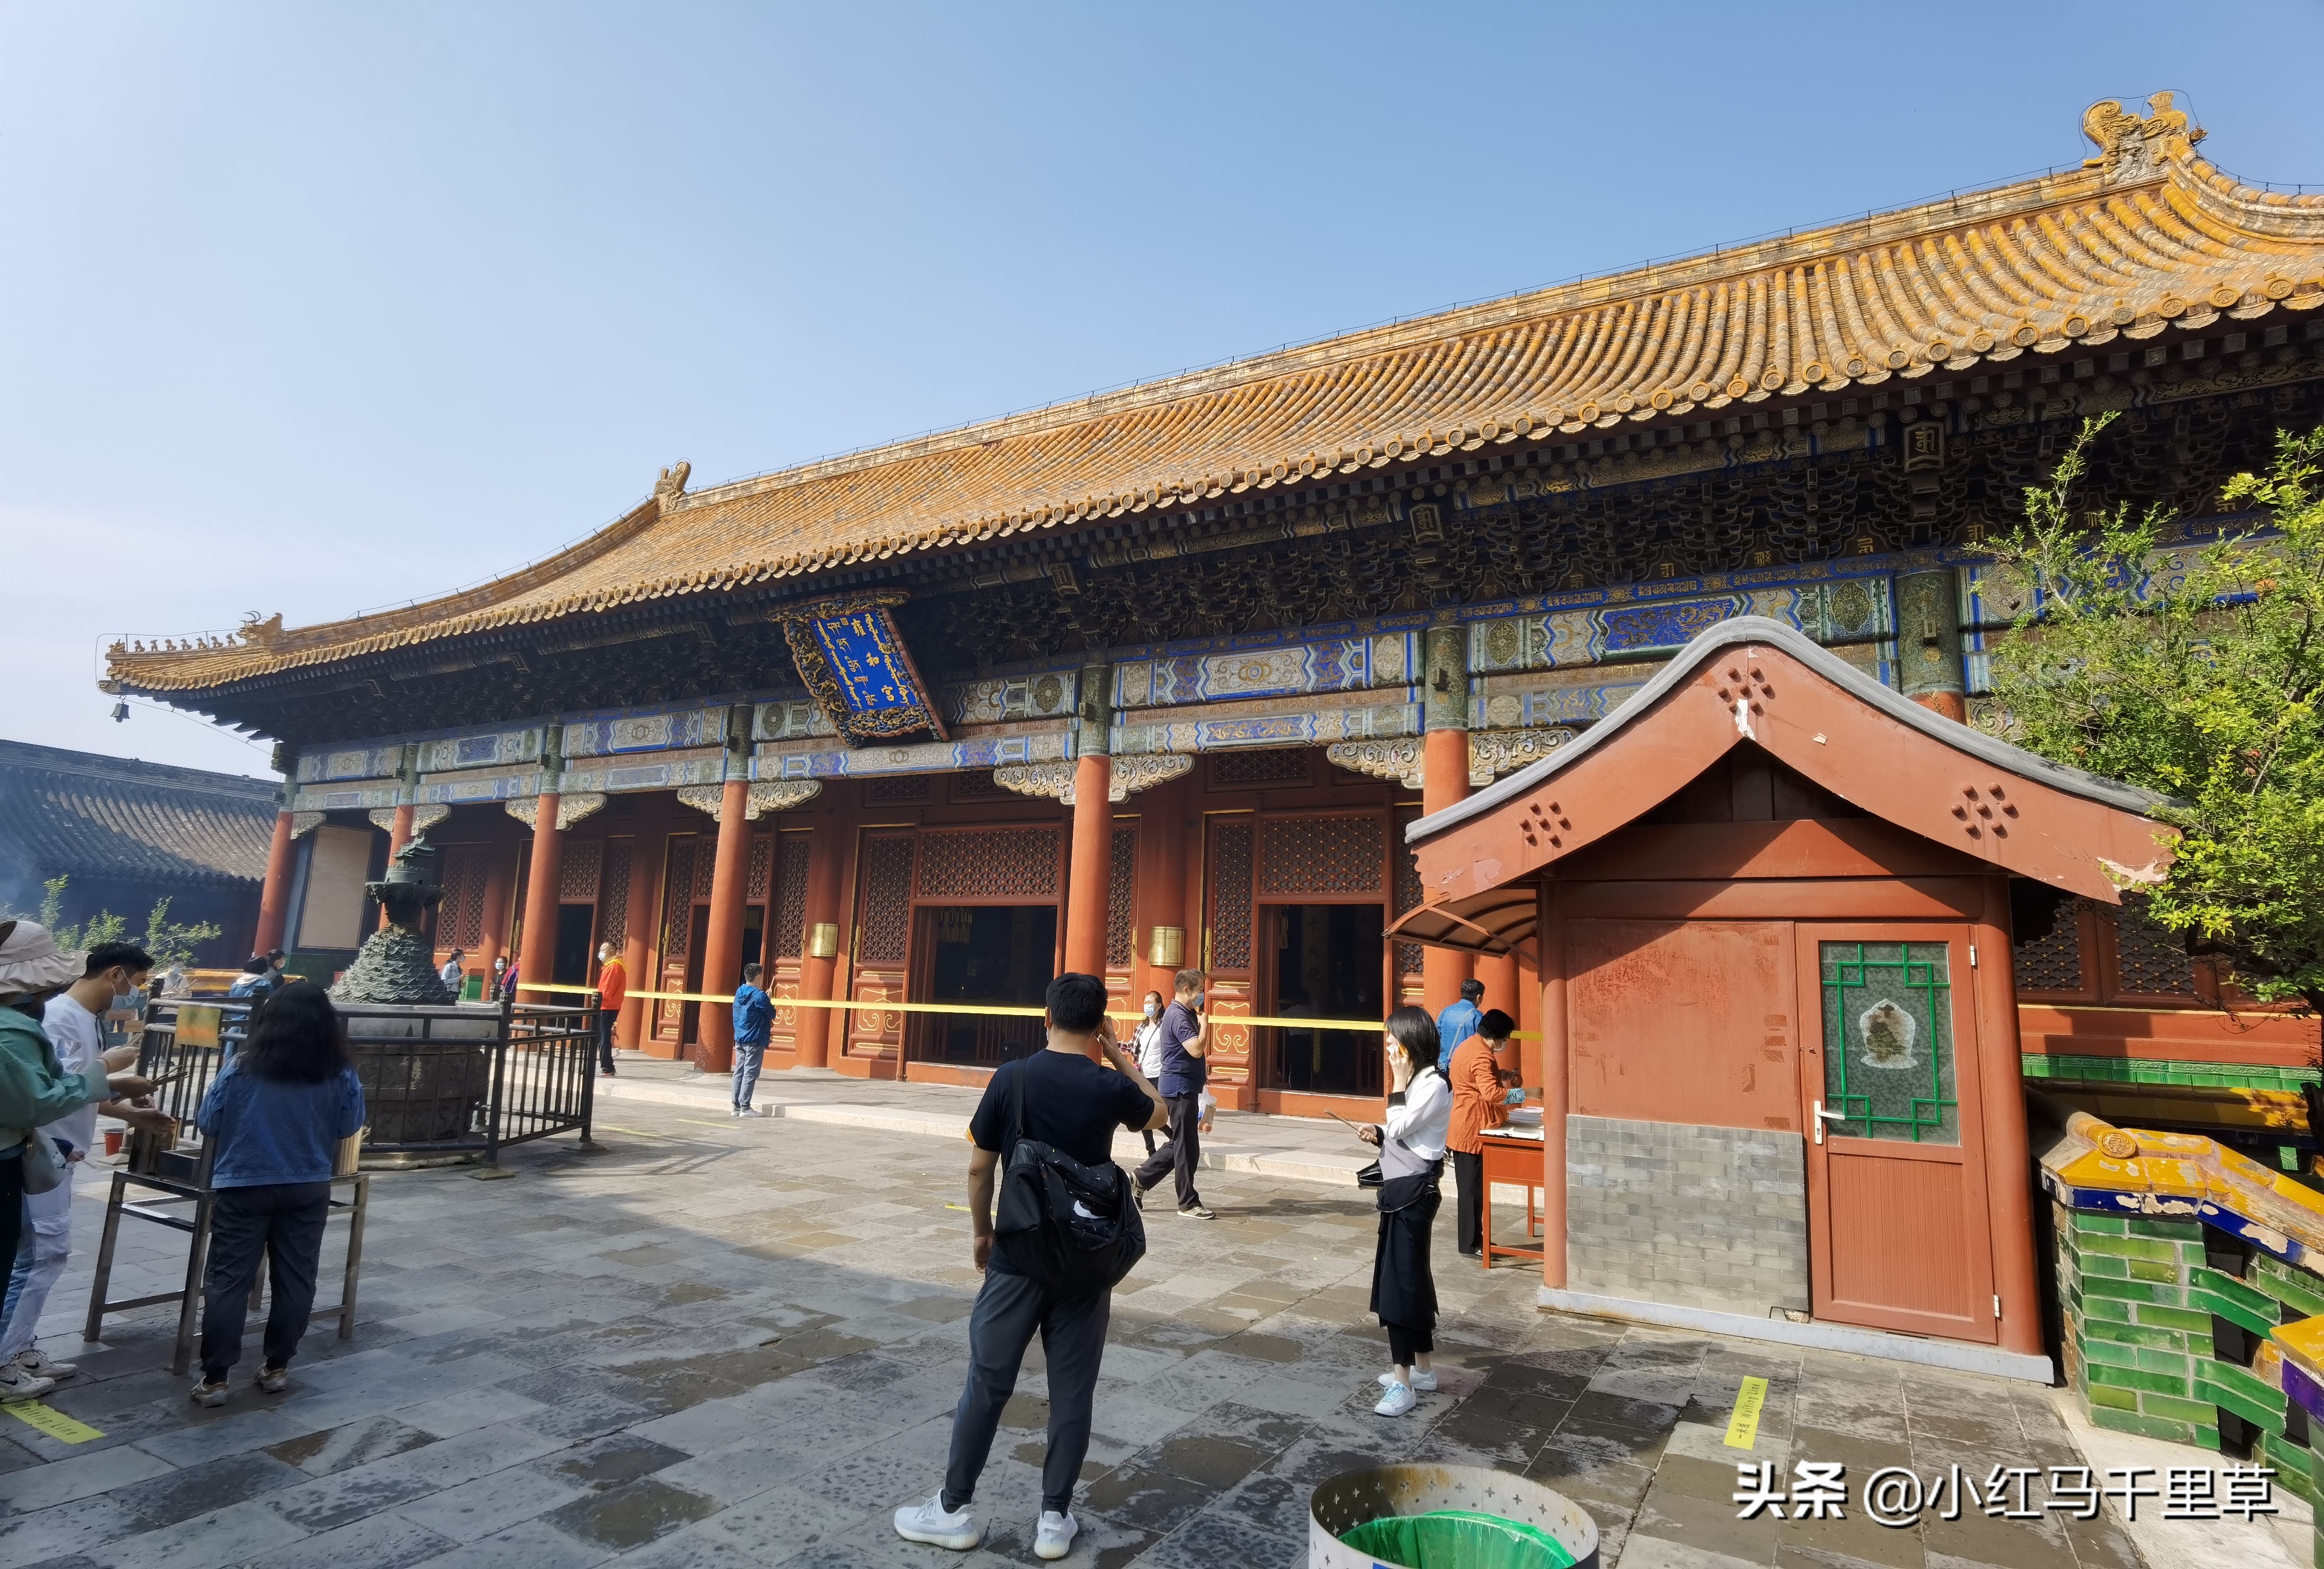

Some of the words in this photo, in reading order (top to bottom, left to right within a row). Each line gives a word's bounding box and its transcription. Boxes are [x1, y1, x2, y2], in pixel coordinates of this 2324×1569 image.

[1747, 1384, 1761, 1395] Line
[1739, 1396, 1759, 1418] Waiting
[50, 1423, 78, 1436] Line
[1735, 1423, 1751, 1439] 一米线
